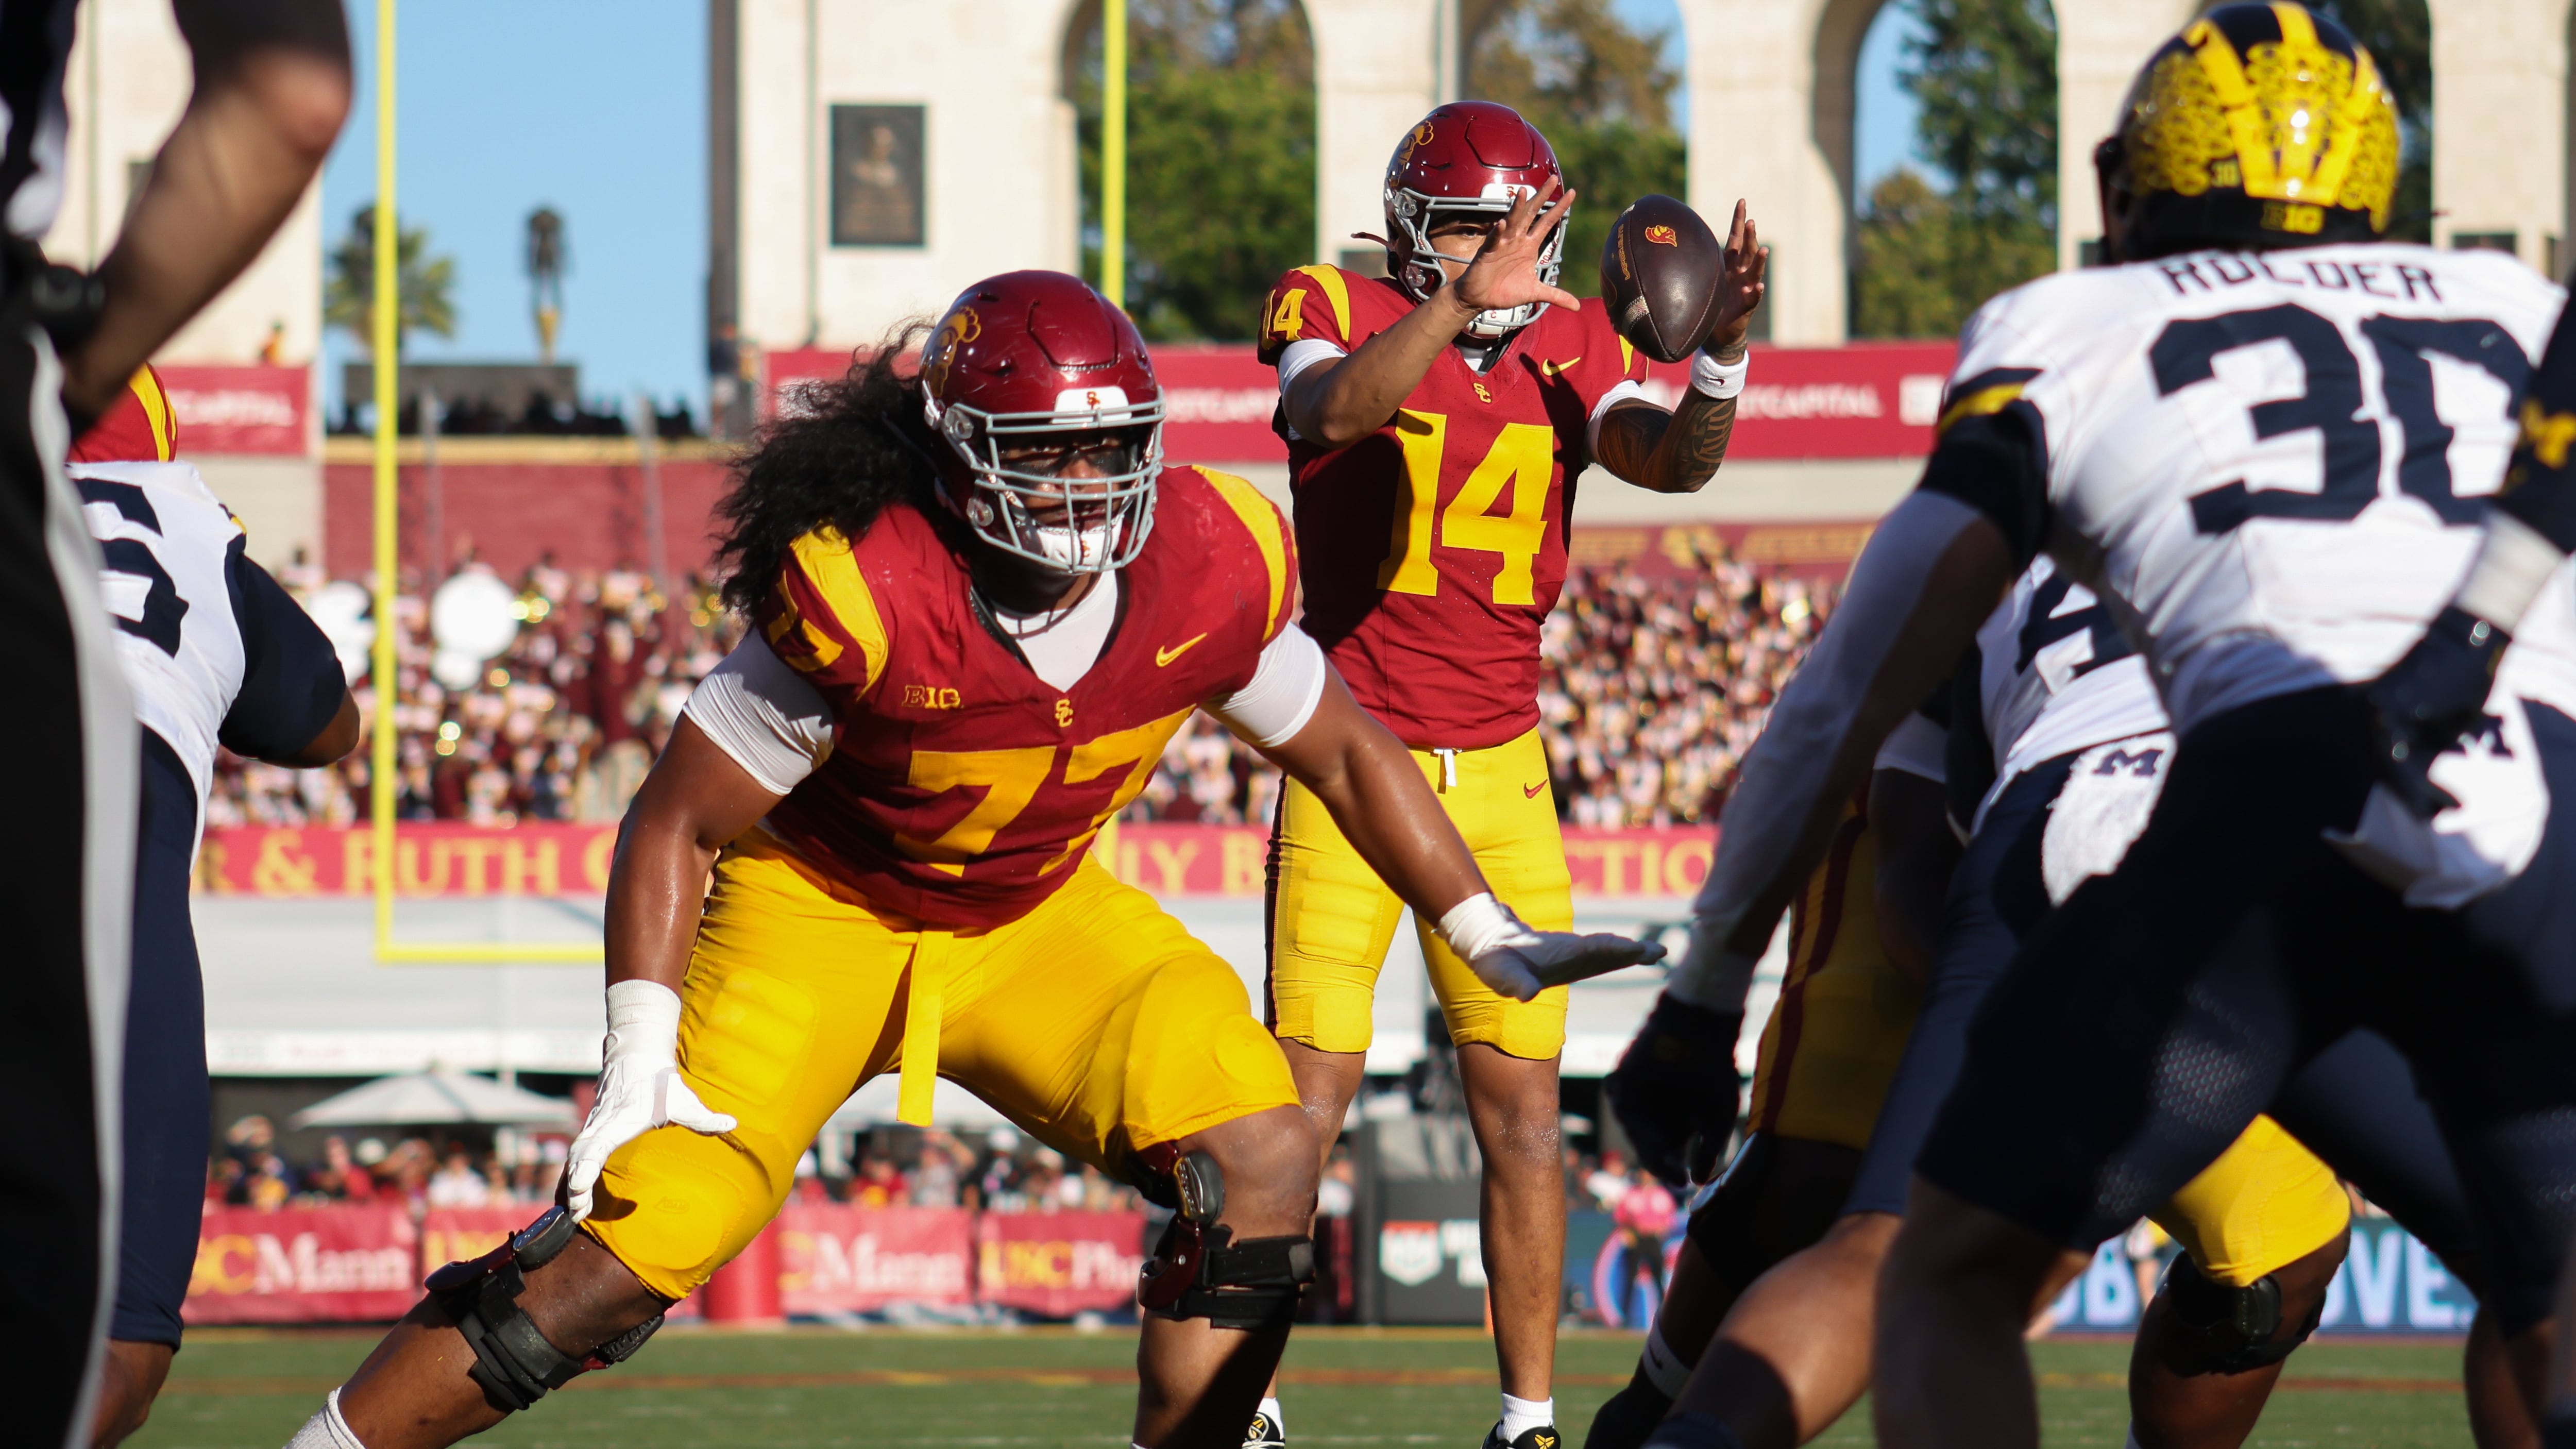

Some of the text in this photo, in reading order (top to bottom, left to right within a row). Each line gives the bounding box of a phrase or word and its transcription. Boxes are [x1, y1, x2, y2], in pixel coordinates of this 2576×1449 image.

[1261, 288, 1308, 350] 14
[1377, 408, 1554, 605] 14
[2147, 302, 2537, 537] 30
[892, 703, 1197, 877] 77
